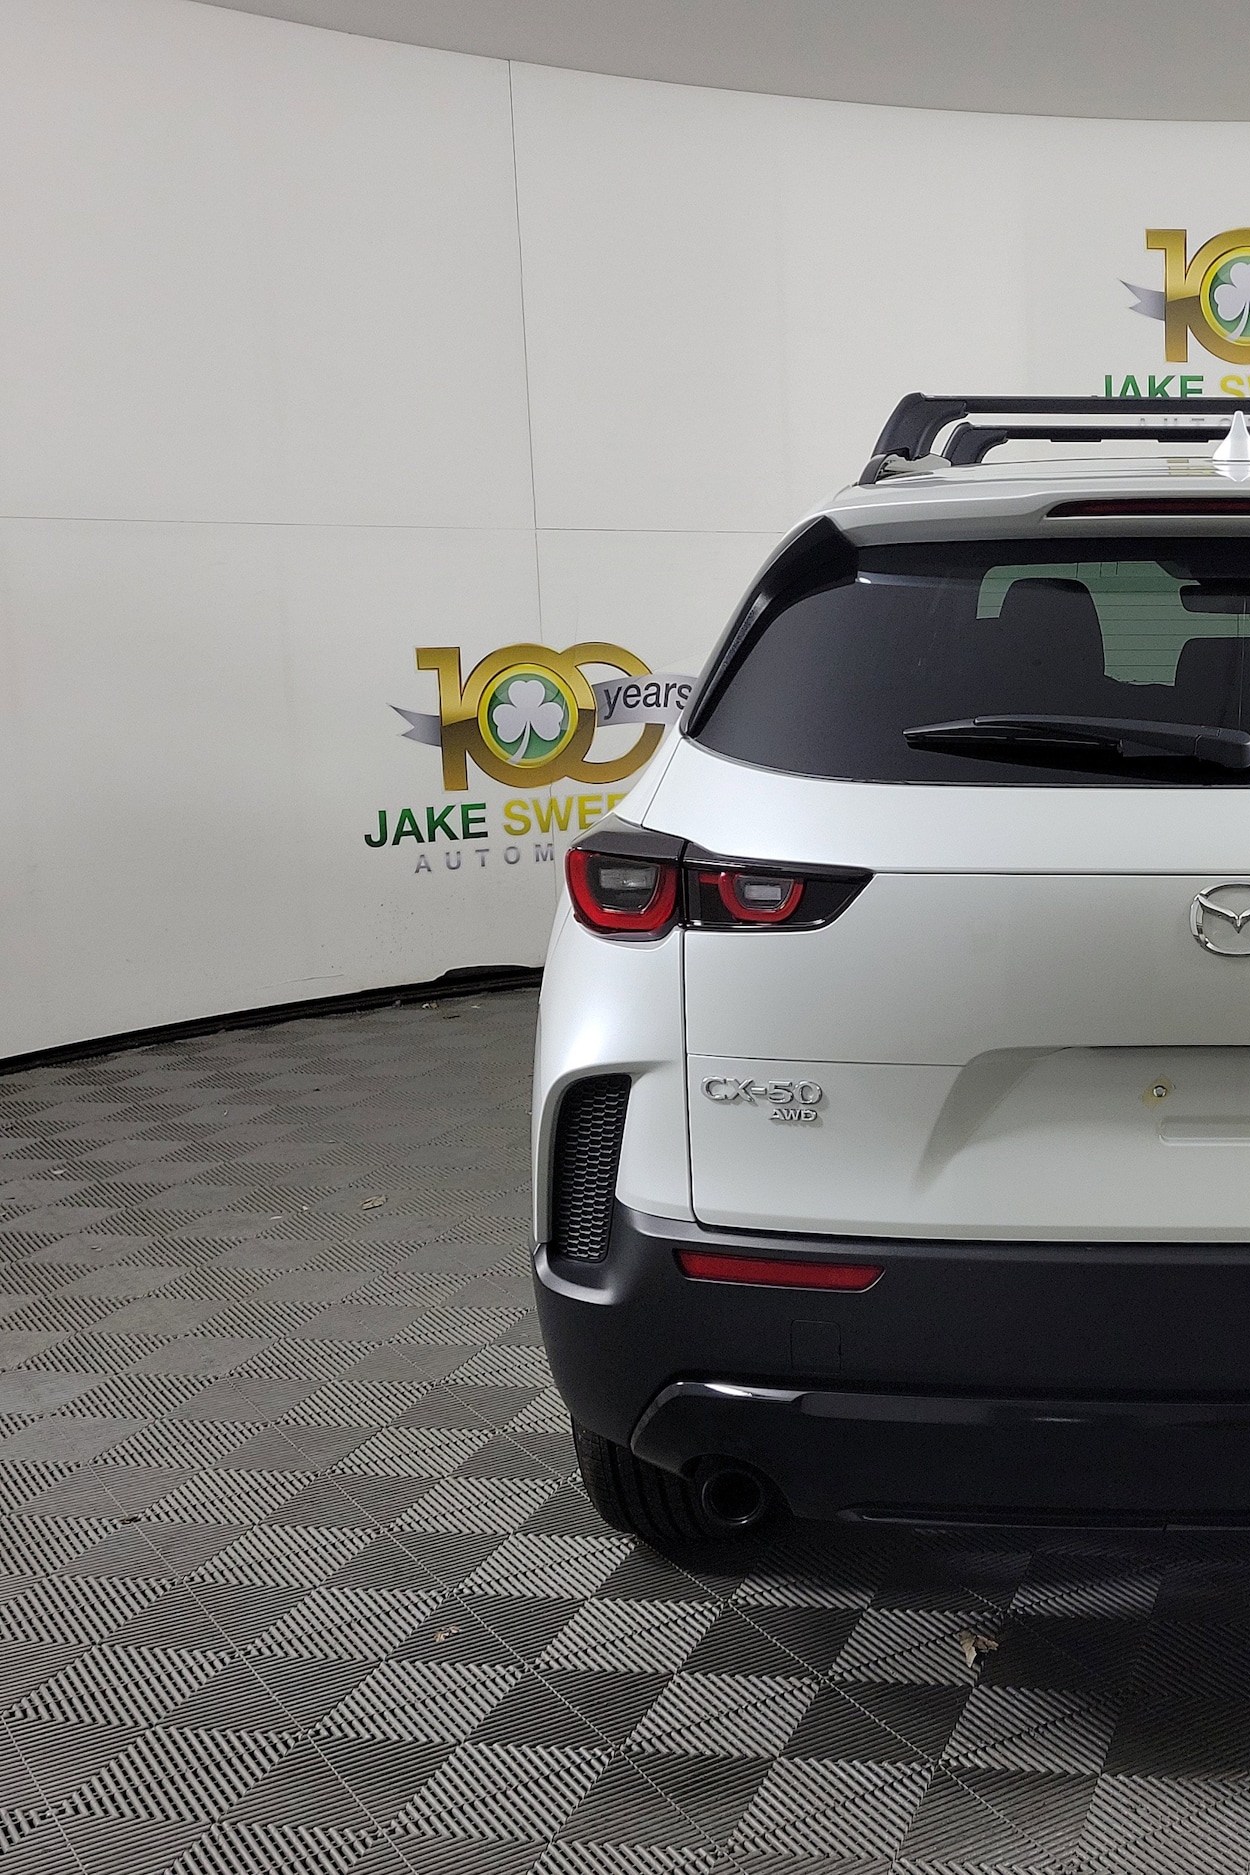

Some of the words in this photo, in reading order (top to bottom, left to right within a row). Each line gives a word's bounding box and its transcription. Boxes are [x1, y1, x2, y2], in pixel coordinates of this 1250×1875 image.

[1091, 375, 1204, 398] JAKE
[416, 642, 665, 791] 100
[603, 682, 692, 720] years
[364, 803, 488, 848] JAKE
[414, 843, 554, 874] AUTOM
[701, 1076, 823, 1105] CX-50
[768, 1108, 818, 1122] AWD
